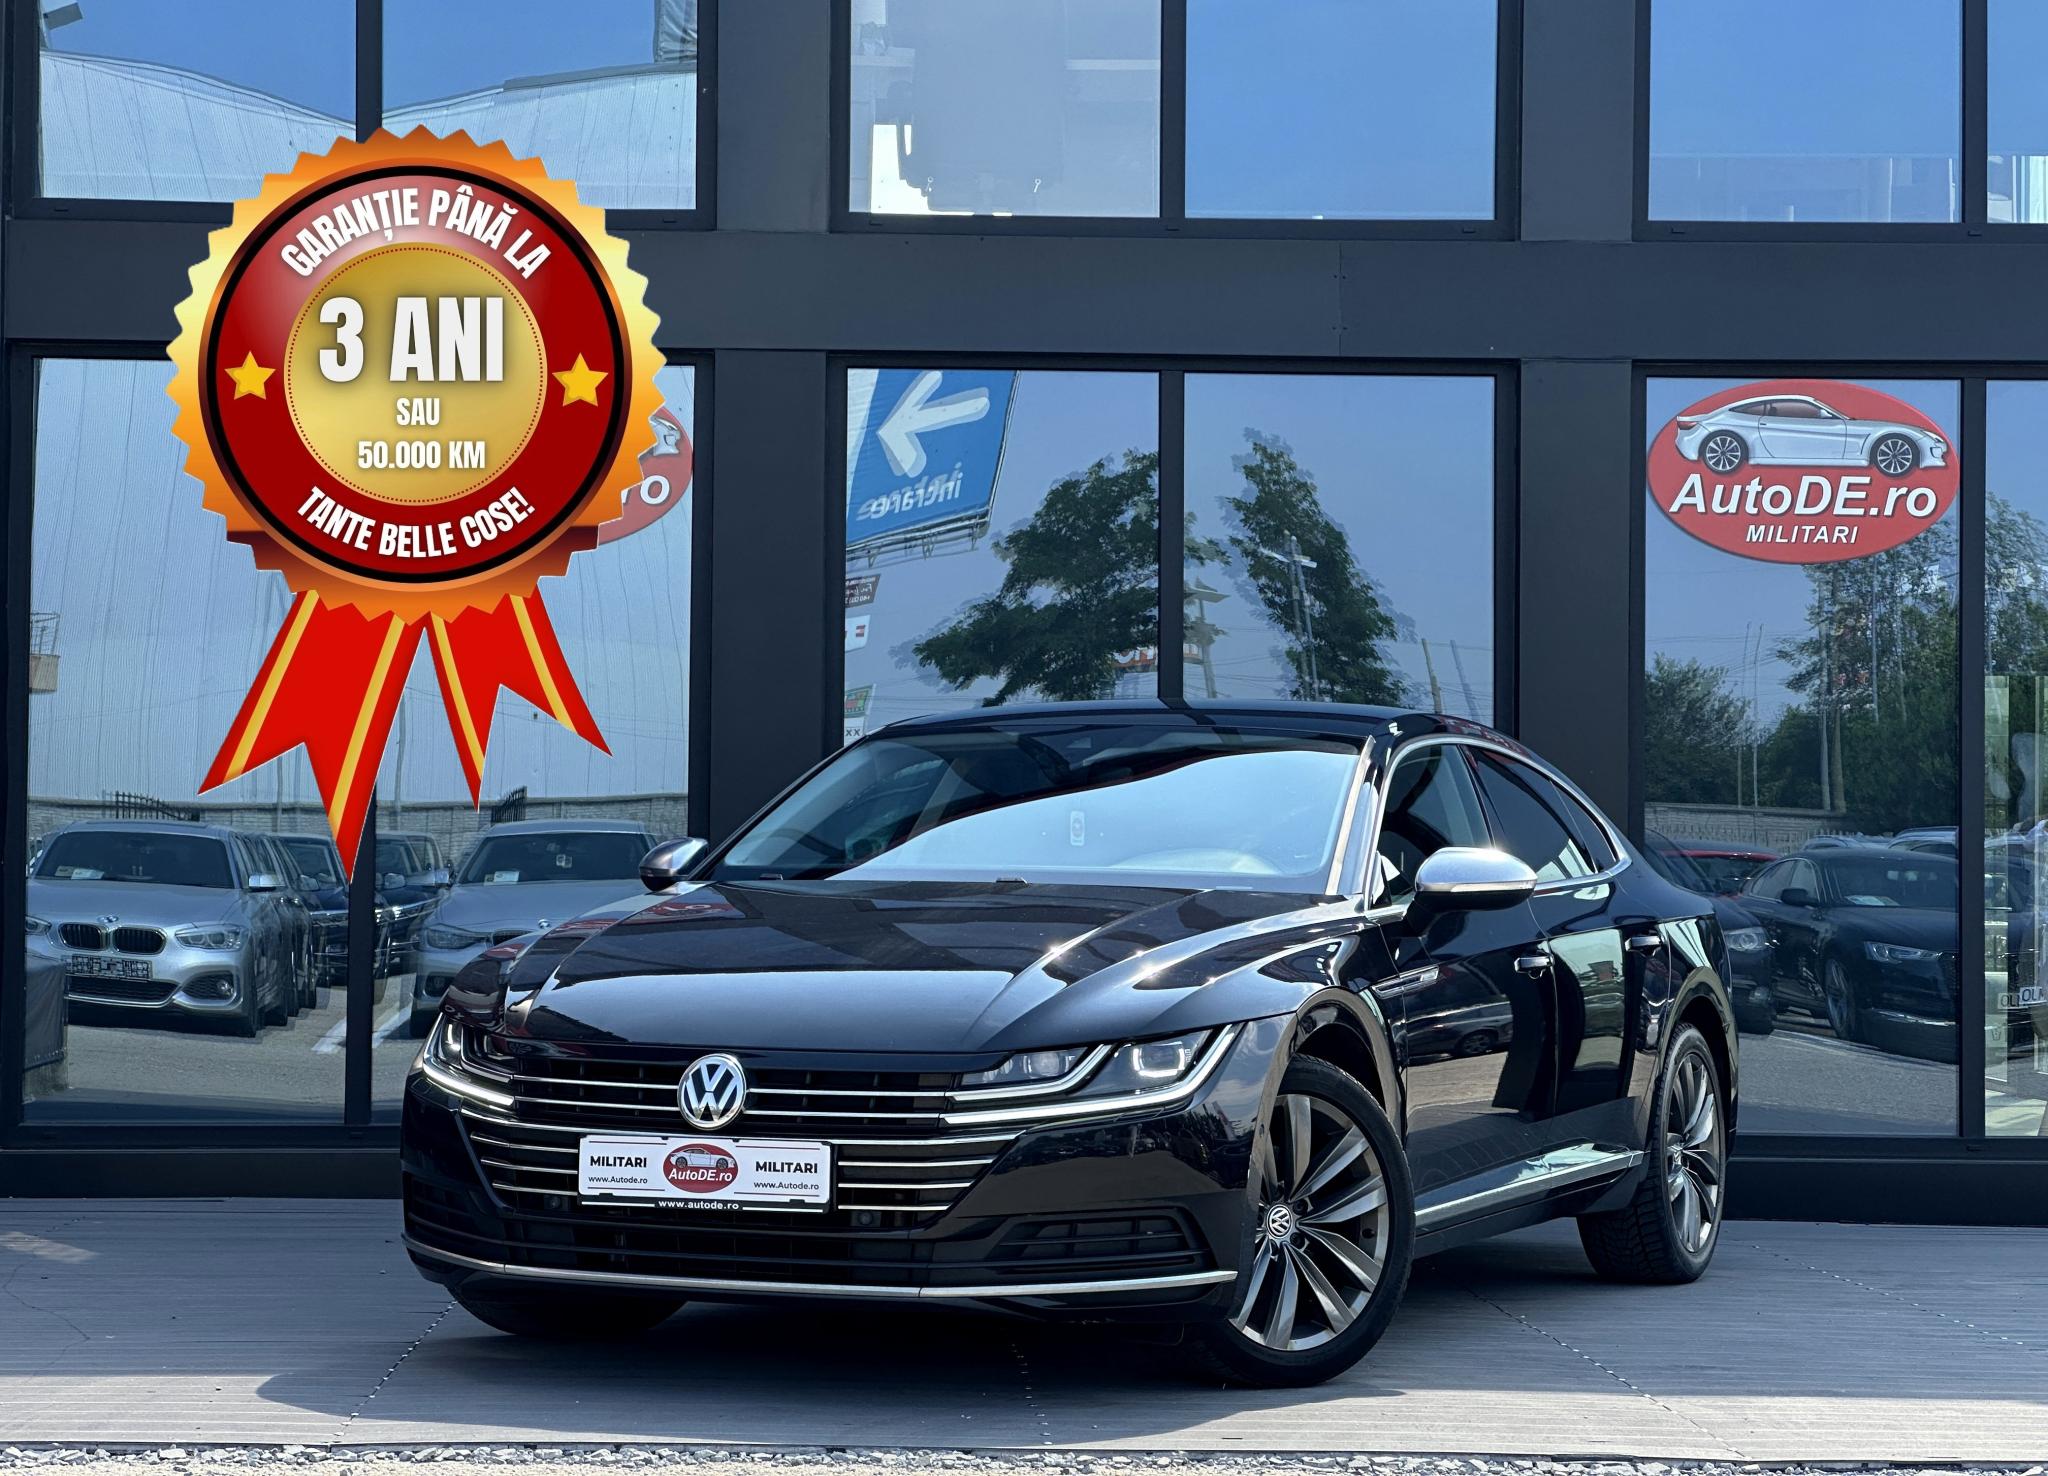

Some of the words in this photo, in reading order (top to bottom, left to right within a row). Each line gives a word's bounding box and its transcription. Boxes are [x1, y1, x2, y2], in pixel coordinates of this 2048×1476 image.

[1669, 472, 1938, 518] AutoDE.ro
[1745, 524, 1859, 545] MILITARI
[590, 1155, 647, 1168] MILITARI
[755, 1161, 818, 1174] MILITARI
[588, 1175, 648, 1184] www.Autode.ro
[668, 1167, 733, 1182] AutoDE.ro
[753, 1181, 820, 1190] www.Autode.ro
[658, 1199, 739, 1210] www.autode.ro
